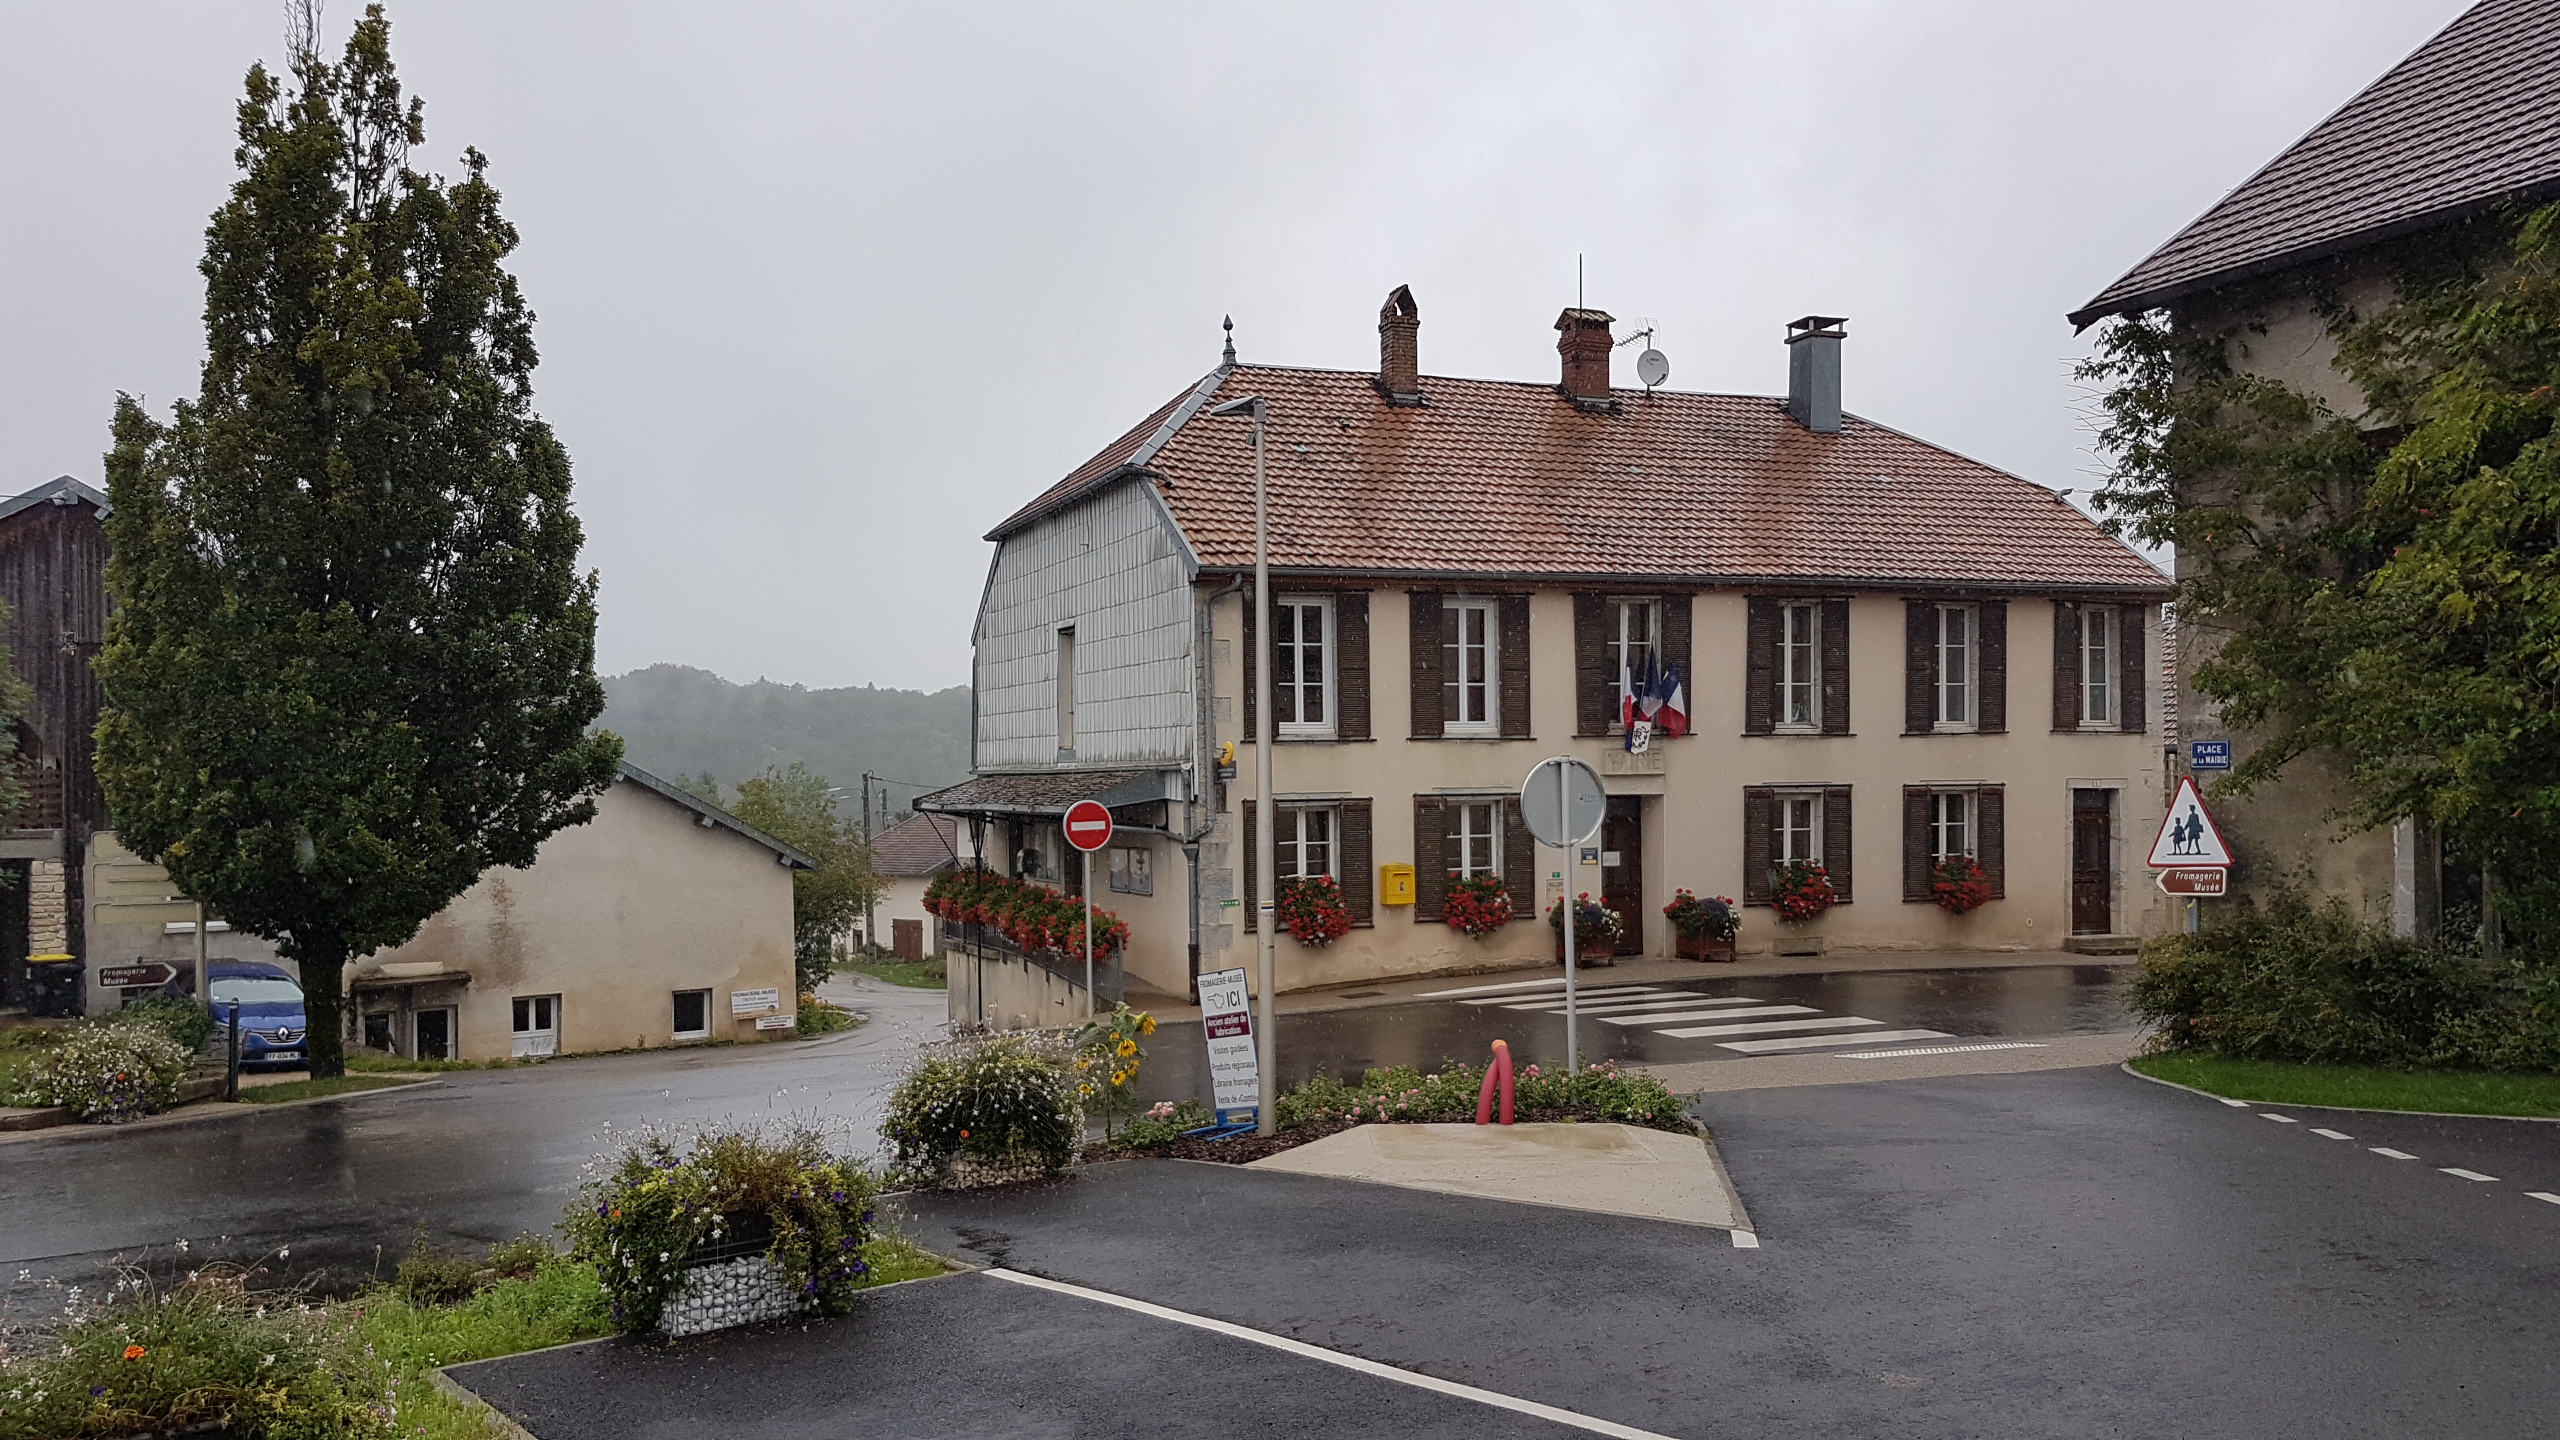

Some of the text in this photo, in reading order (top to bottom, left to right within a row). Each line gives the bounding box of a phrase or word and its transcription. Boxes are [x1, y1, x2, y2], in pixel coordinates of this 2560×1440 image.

[2197, 745, 2222, 754] PLACE
[1608, 752, 1660, 771] MAIRIE
[2205, 755, 2228, 764] MAIRIE
[2175, 871, 2221, 882] Fromagerie
[2194, 882, 2221, 892] Musée
[103, 967, 147, 977] Fromagerie
[1226, 990, 1241, 1008] ICI
[1207, 1013, 1247, 1027] Ancien atelier de
[1215, 1026, 1242, 1037] fabrication
[1212, 1043, 1249, 1056] Visites guidées
[1211, 1061, 1255, 1072] Produits régionaux
[1216, 1095, 1231, 1104] Vente
[1231, 1094, 1238, 1103] de
